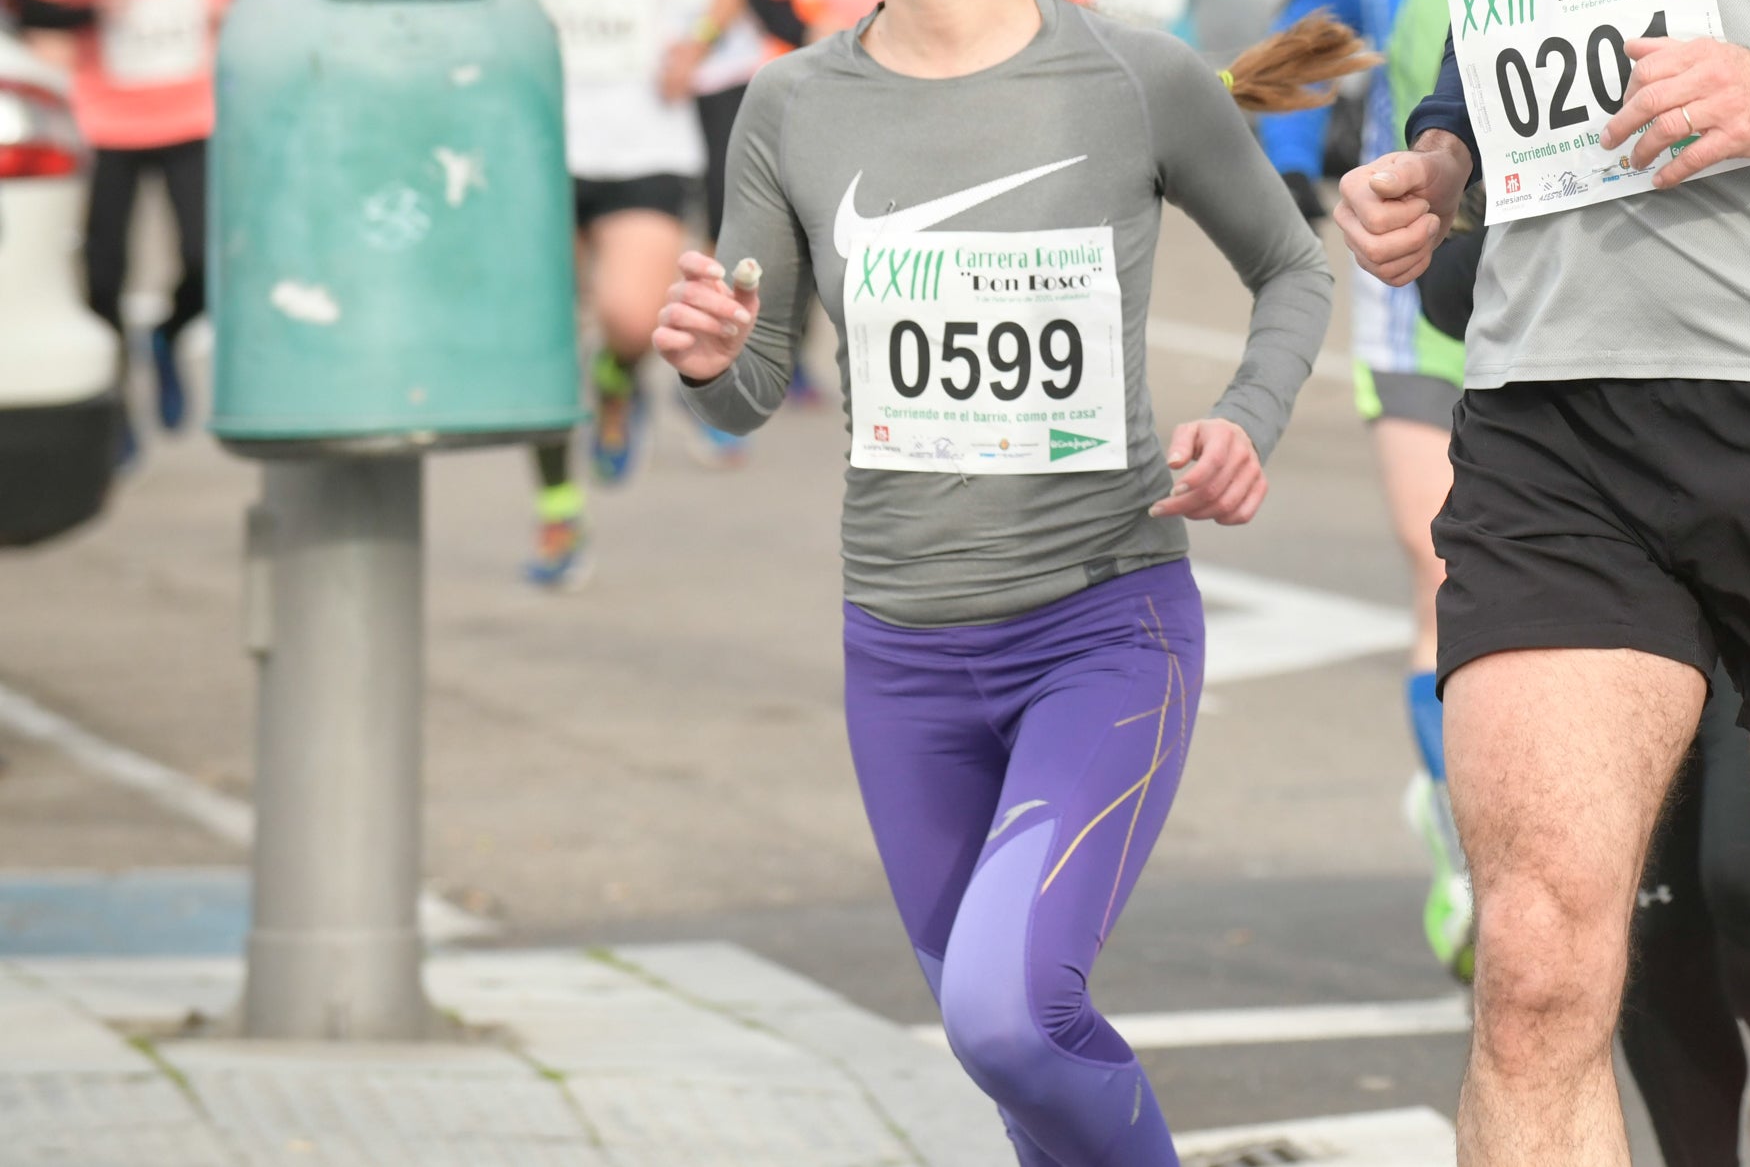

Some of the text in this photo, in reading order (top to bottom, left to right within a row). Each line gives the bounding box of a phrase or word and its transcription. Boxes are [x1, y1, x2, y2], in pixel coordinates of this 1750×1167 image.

[1569, 3, 1579, 12] de
[1559, 141, 1571, 155] en
[1573, 135, 1585, 149] el
[1495, 193, 1533, 207] salesianos
[853, 244, 1105, 303] XXIII Carrera Popular
[889, 319, 1084, 402] 0599
[943, 411, 957, 420] en
[960, 411, 969, 422] el
[1016, 411, 1047, 423] como
[1051, 411, 1065, 421] en
